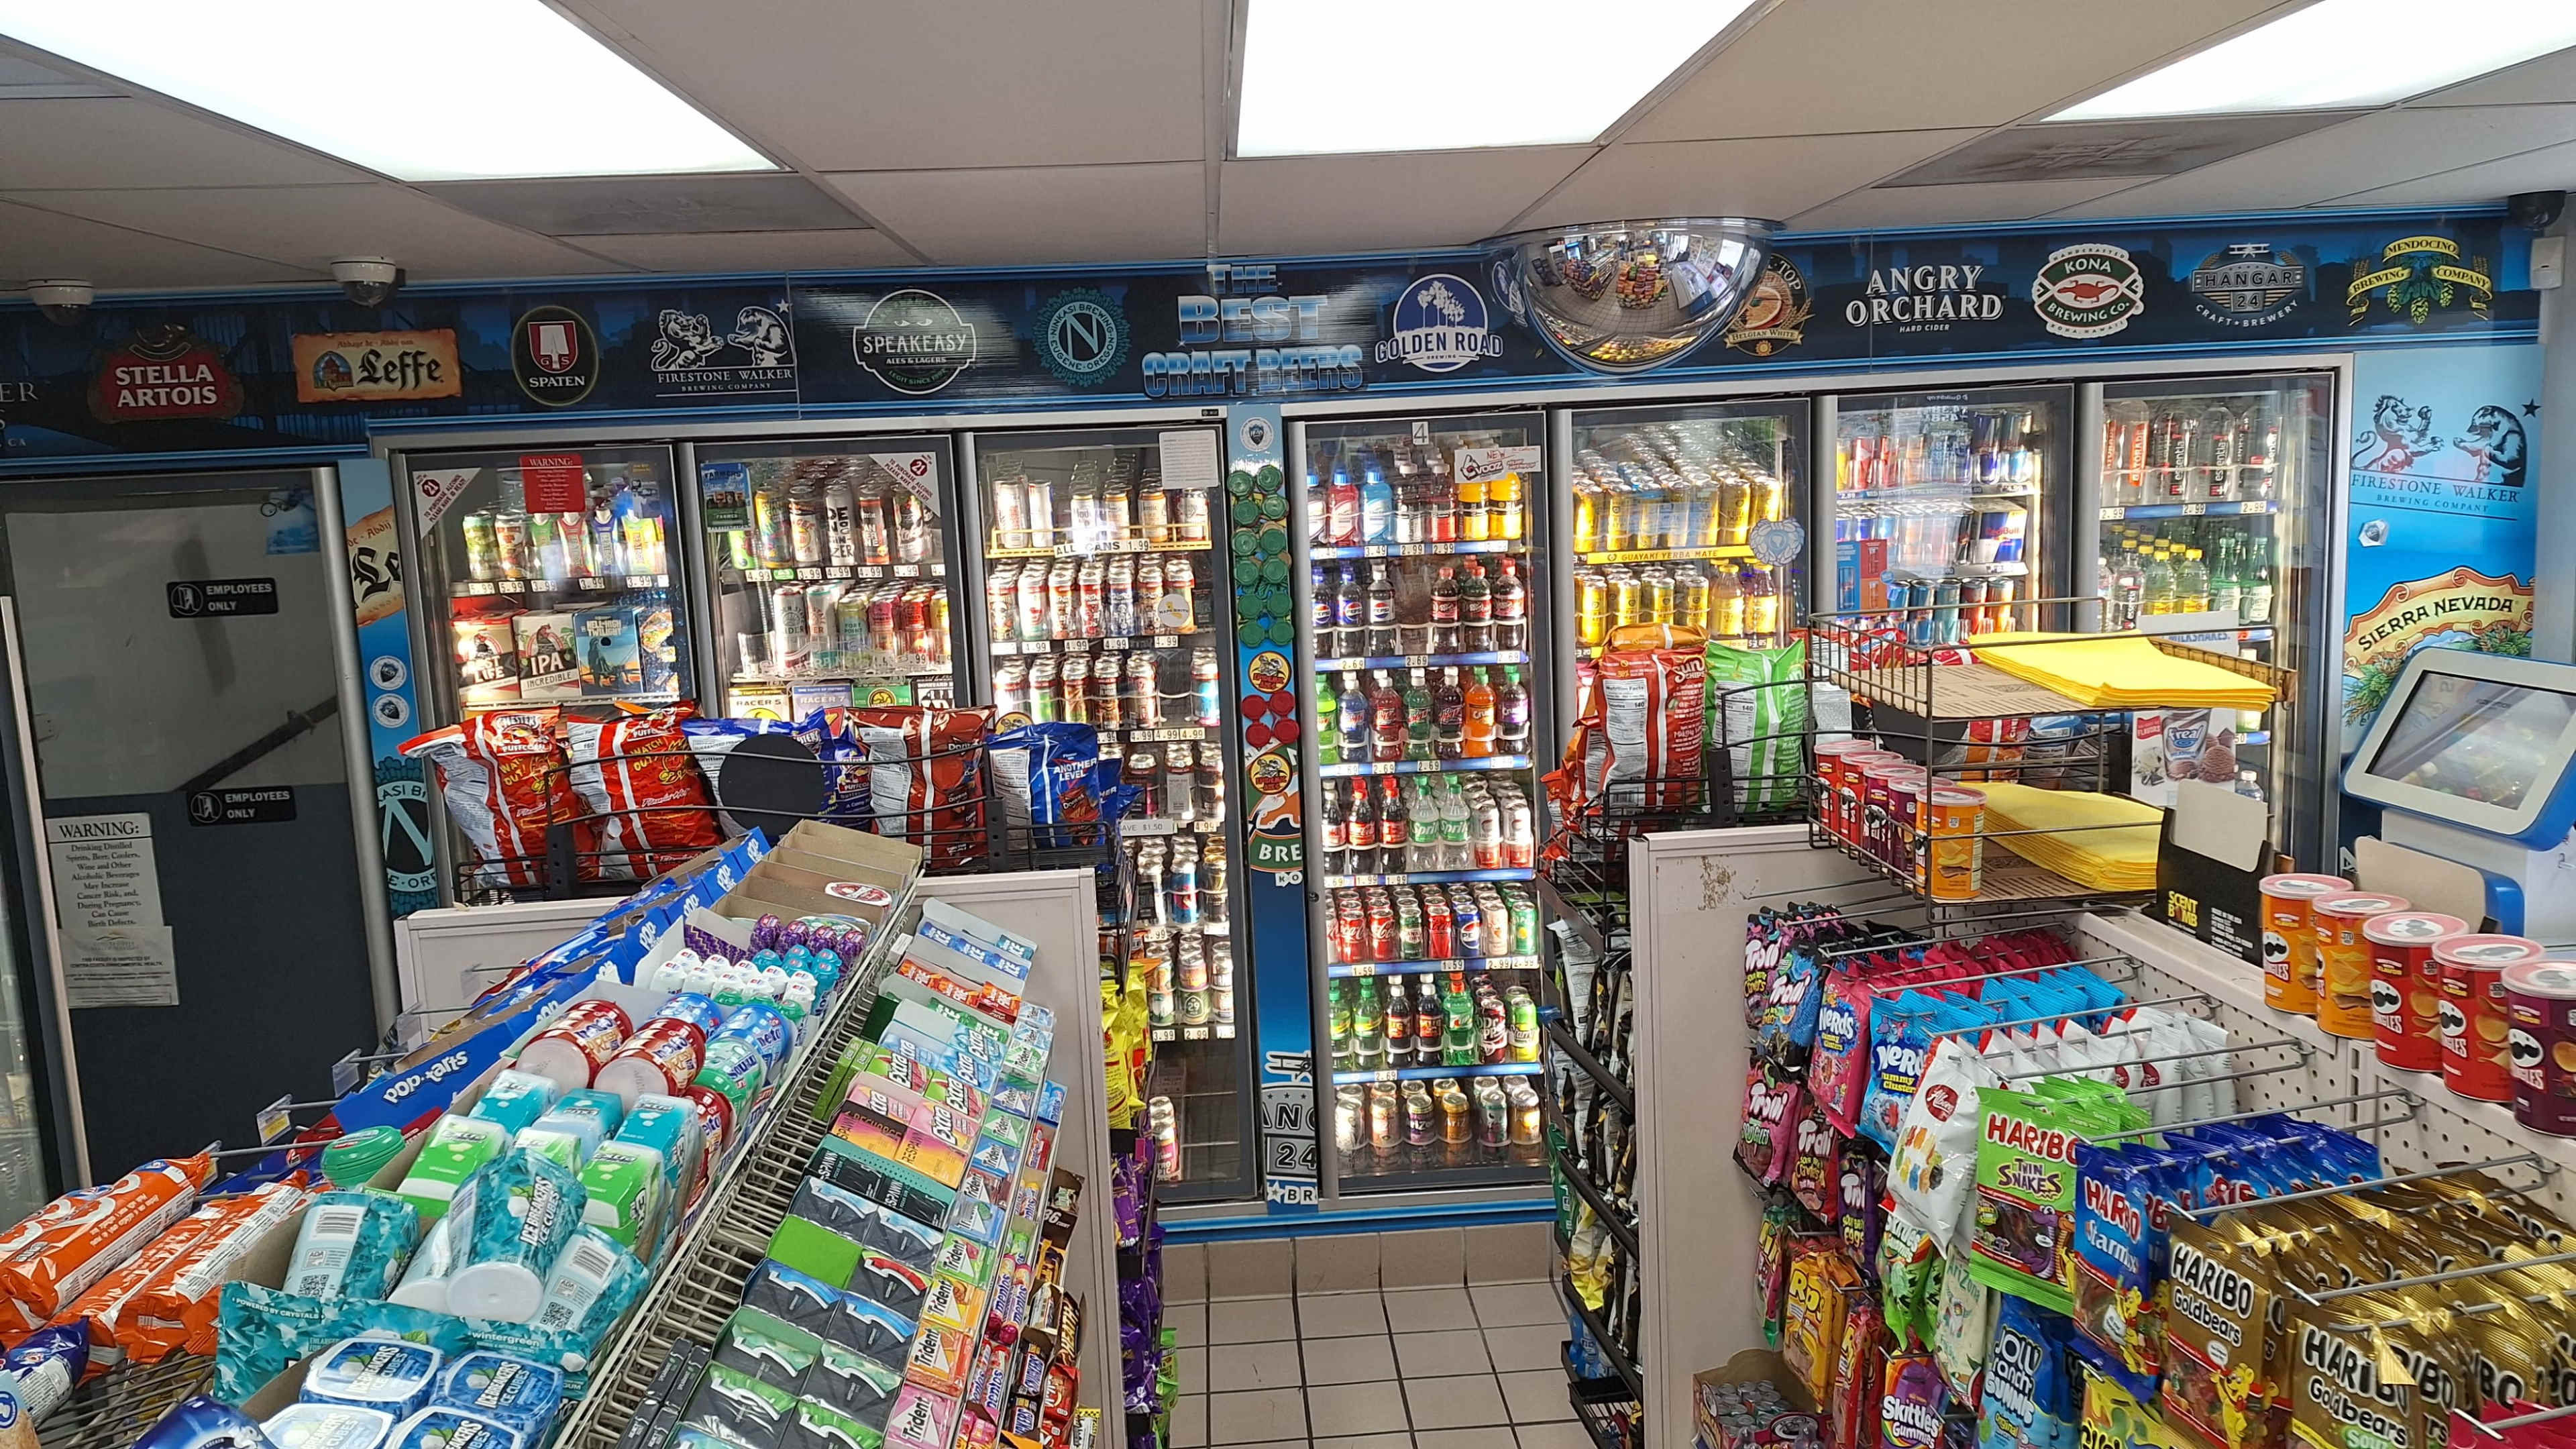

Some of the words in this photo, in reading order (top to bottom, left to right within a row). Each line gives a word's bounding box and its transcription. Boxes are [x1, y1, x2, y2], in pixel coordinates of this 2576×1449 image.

[2388, 239, 2457, 254] MENDOCINO
[2053, 248, 2125, 261] HANDCRAFTED
[2064, 258, 2111, 274] KONA
[1207, 264, 1279, 295] THE
[1779, 262, 1802, 291] TOP
[1866, 264, 1984, 295] ANGRY
[2205, 271, 2293, 287] HANGAR
[2353, 269, 2404, 292] BREWING
[2436, 268, 2488, 288] COMPANY
[2237, 293, 2260, 308] 24
[1845, 293, 2004, 327] ORCHARD
[2047, 303, 2107, 322] BREWING
[2196, 304, 2233, 325] CRAFT
[2243, 299, 2298, 327] BREWERY
[1051, 305, 1077, 336] NINKASI
[1078, 303, 1114, 333] BREWING
[1176, 295, 1328, 346] BEST
[1731, 330, 1767, 341] BELGIAN
[1768, 328, 1796, 339] WHITE
[1899, 325, 1922, 333] HARD
[1925, 323, 1950, 331] CIDER
[863, 333, 966, 354] SPEAKEASY
[1375, 331, 1448, 364] GOLDEN
[1453, 331, 1504, 359] ROAD
[915, 356, 947, 364] LAGERS
[1051, 339, 1082, 370] EUGENE
[1086, 337, 1114, 370] OREGON
[115, 364, 215, 386] STELLA
[356, 348, 441, 391] Leffe
[657, 370, 731, 384] FIRESTONE
[737, 367, 794, 381] WALKER
[1142, 349, 1250, 400] CRAFT
[1257, 344, 1364, 396] BEERS
[528, 375, 586, 389] SPATEN
[681, 384, 725, 392] BREWING
[727, 382, 771, 390] COMPANY
[117, 386, 218, 408] ARTOIS
[1412, 423, 1428, 443] 4
[529, 457, 574, 468] WARNING:
[1487, 450, 1506, 460] NEW
[913, 462, 927, 476] 21
[425, 481, 439, 494] 21
[2351, 473, 2443, 496] FIRESTONE
[2453, 484, 2518, 503] WALKER
[2183, 504, 2206, 515] 2.99
[2243, 502, 2265, 513] 2.99
[2377, 494, 2429, 506] BREWING
[2434, 501, 2489, 513] COMPANY
[2101, 508, 2125, 519] 2.99
[1056, 544, 1076, 556] ALL
[1085, 541, 1121, 553] CANS
[1127, 540, 1150, 551] 1.99
[1365, 545, 1387, 556] 3.49
[1401, 545, 1424, 555] 2.99
[1433, 543, 1455, 553] 2.99
[1621, 552, 1660, 561] GUAYAKI
[1661, 551, 1690, 559] YERBA
[1695, 550, 1718, 558] MATE
[746, 570, 772, 582] 4.99
[797, 568, 822, 580] 3.99
[826, 566, 851, 579] 4.99
[858, 566, 883, 578] 4.99
[894, 564, 919, 576] 4.99
[205, 582, 272, 595] EMPLOYEES
[470, 582, 494, 594] 5.99
[500, 582, 525, 593] 5.99
[532, 580, 557, 592] 3.99
[580, 578, 604, 590] 3.99
[627, 577, 652, 588] 3.99
[209, 600, 237, 611] ONLY
[2359, 605, 2429, 653] SIERRA
[2433, 596, 2514, 619] NEVADA
[1066, 641, 1088, 651] 4.99
[1105, 639, 1128, 649] 4.99
[1155, 637, 1178, 647] 4.99
[1342, 659, 1364, 669] 2.69
[1407, 655, 1428, 665] 2.69
[1498, 651, 1519, 662] 2.69
[532, 653, 566, 676] IPA
[527, 672, 572, 689] INCREDIBLE
[800, 697, 837, 705] RACER
[1131, 731, 1152, 741] 4.99
[1155, 729, 1179, 739] 4.99
[1180, 729, 1203, 739] 4.99
[1053, 758, 1097, 774] ANOTHER
[1373, 763, 1394, 773] 2.69
[1418, 761, 1440, 771] 2.69
[1059, 770, 1088, 782] LEVEL
[225, 790, 290, 803] EMPLOYEES
[227, 808, 256, 818] ONLY
[58, 820, 140, 839] WARNING:
[1142, 823, 1163, 831] $1.50
[70, 843, 103, 853] Drinking
[103, 841, 133, 850] Distilled
[76, 863, 96, 871] Wine
[97, 862, 110, 870] and
[111, 861, 131, 869] Other
[71, 872, 103, 881] Alcoholic
[105, 871, 140, 880] Beverages
[1387, 875, 1407, 885] 1.99
[83, 882, 100, 891] May
[101, 880, 129, 889] Increase
[76, 892, 103, 900] Cancer
[2168, 890, 2198, 912] SCENT
[77, 902, 103, 910] During
[91, 910, 106, 918] Can
[107, 909, 129, 918] Cause
[88, 919, 107, 928] Birth
[1746, 936, 1782, 971] Trolli
[1352, 964, 1374, 975] 1.59
[1442, 959, 1463, 970] 1.59
[1488, 957, 1509, 968] 2.99
[1153, 1030, 1175, 1040] 3.99
[1185, 1030, 1208, 1039] 2.99
[889, 1053, 909, 1087] Extra
[958, 1052, 977, 1085] Extra
[1375, 1071, 1397, 1081] 2.69
[946, 1077, 967, 1112] Extra
[1749, 1081, 1789, 1122] Trolli
[931, 1106, 953, 1144] Extra
[1798, 1118, 1835, 1157] Trolli
[1986, 1112, 2079, 1167] HARIBO
[983, 1144, 1004, 1168] Trident
[2013, 1157, 2043, 1175] TWIN
[965, 1173, 984, 1196] Trident
[1997, 1165, 2063, 1201] SNAKES
[526, 1176, 553, 1234] BREAKERS
[2084, 1176, 2143, 1241] HARIBO
[2086, 1219, 2141, 1274] Starmix
[943, 1239, 964, 1272] Trident
[2171, 1241, 2255, 1319] HARIBO
[927, 1279, 955, 1317] Trident
[996, 1273, 1010, 1317] mentos
[236, 1297, 269, 1313] POWERED
[280, 1309, 321, 1320] CRYSTALS
[1014, 1283, 1027, 1325] mentos
[2173, 1285, 2243, 1346] Goldbears
[472, 1330, 541, 1348] wintergreen
[915, 1328, 939, 1366] Trident
[1994, 1326, 2043, 1373] JOLLY
[1024, 1352, 1045, 1393] SNICKERS
[1882, 1393, 1940, 1438] Skittles
[2308, 1372, 2409, 1448] Goldbears
[902, 1396, 929, 1441] Trident
[1892, 1420, 1937, 1449] Gummies
